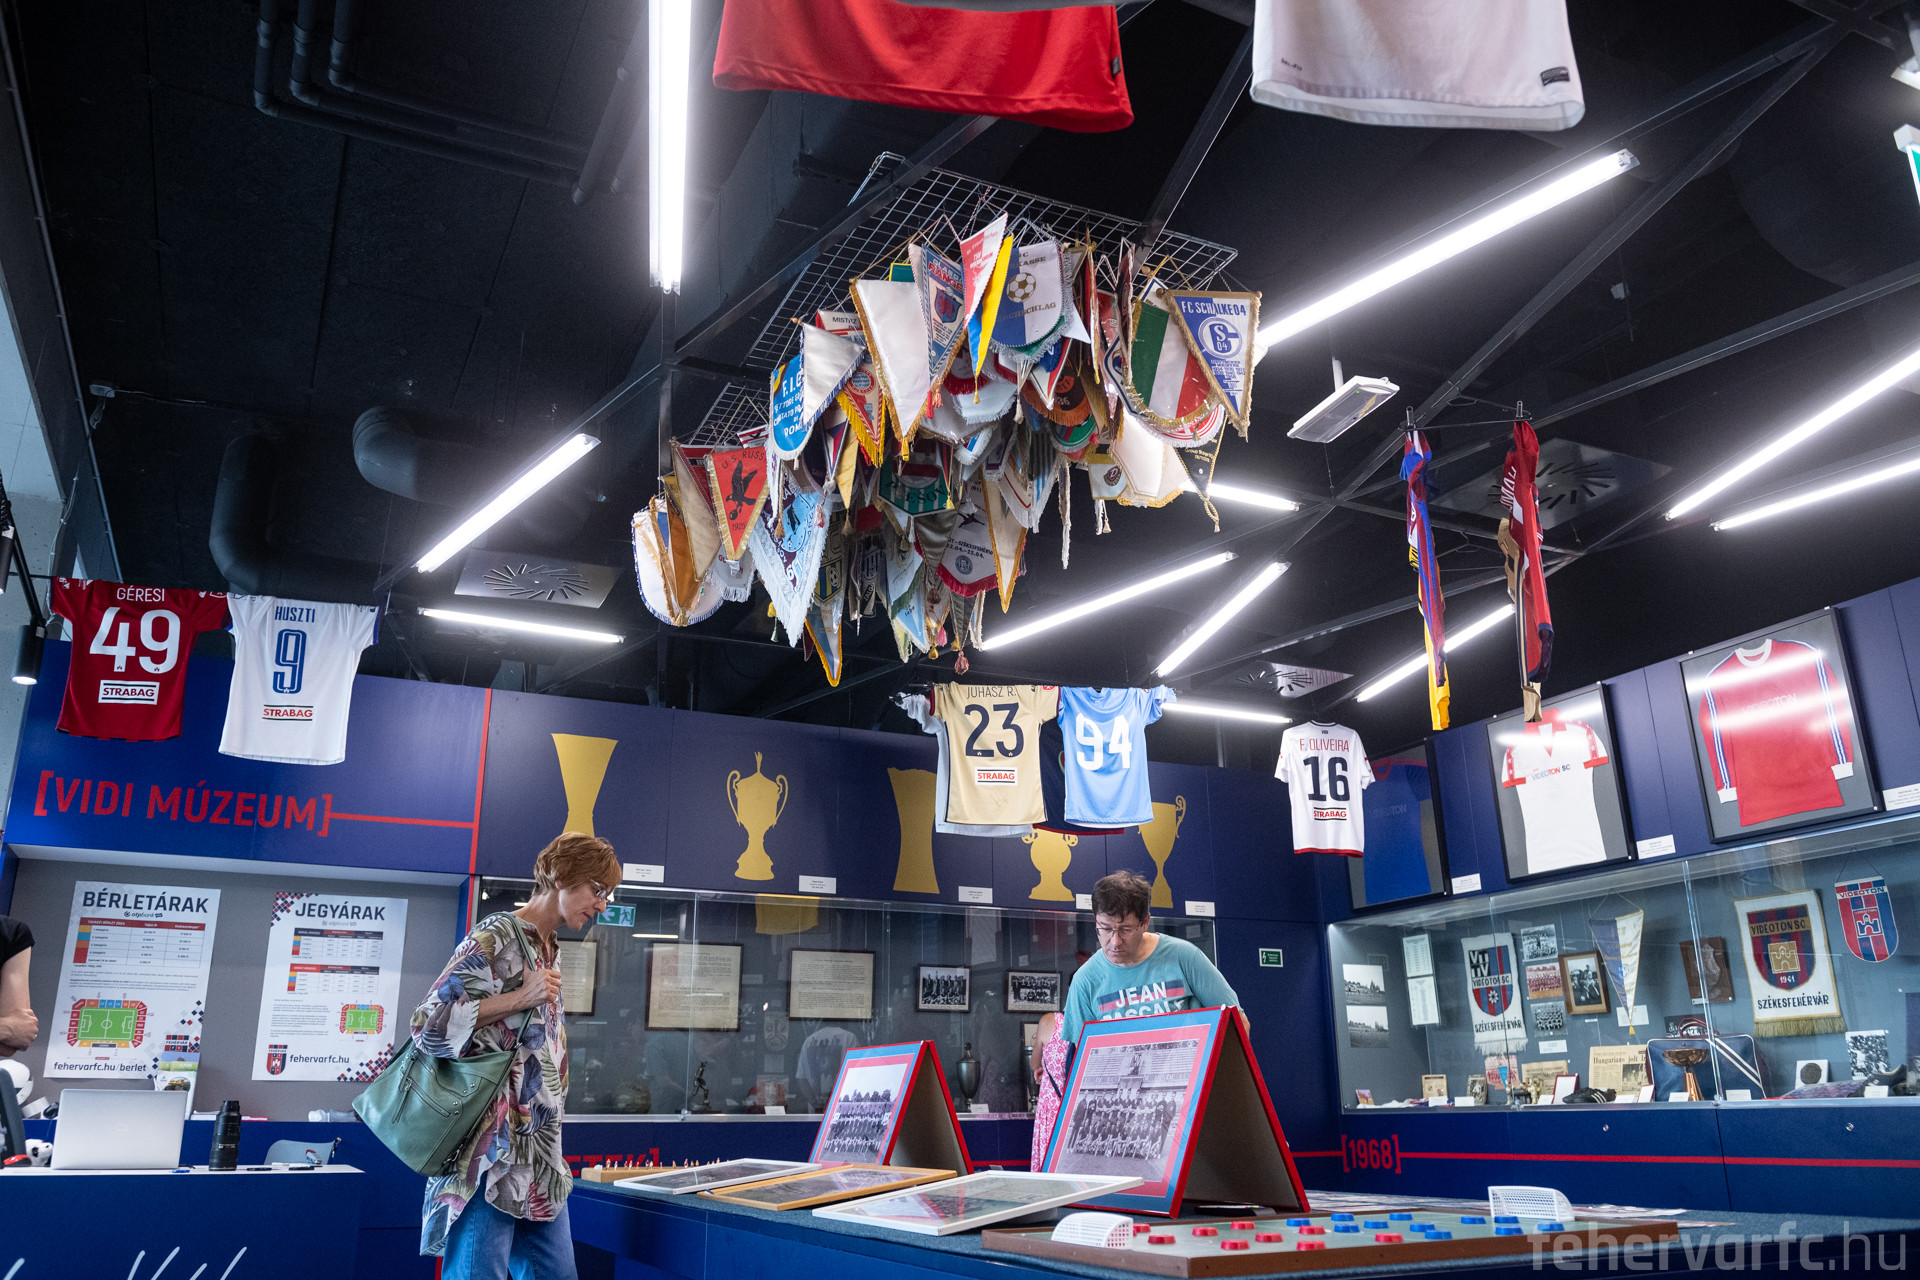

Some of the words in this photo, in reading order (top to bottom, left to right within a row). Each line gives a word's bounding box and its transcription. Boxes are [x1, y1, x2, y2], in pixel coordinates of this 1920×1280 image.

[1181, 301, 1194, 314] FC
[1195, 302, 1234, 316] SCHALKE
[1234, 304, 1247, 317] 04
[722, 462, 729, 470] U
[731, 455, 737, 463] S
[731, 521, 746, 531] 1925
[116, 583, 166, 603] GÉRESI
[274, 605, 316, 624] HUSZTI
[89, 606, 182, 674] 49
[272, 628, 308, 695] 9
[102, 684, 155, 699] STRABAG
[262, 706, 314, 720] STRABAG
[964, 702, 1025, 758] 23
[1075, 712, 1132, 771] 94
[1299, 738, 1307, 751] F.
[1309, 738, 1350, 753] OLIVEIRA
[977, 771, 1016, 781] STRABAG
[1561, 763, 1571, 772] SC
[1303, 756, 1351, 802] 16
[34, 769, 133, 817] [VIDI
[146, 779, 334, 838] MÚZEUM]
[1313, 809, 1347, 819] STRABAG
[1839, 886, 1885, 898] VIDEOTON
[82, 888, 210, 914] BÉRLETÁRAK
[295, 901, 386, 921] JEGYÁRAK
[1750, 922, 1793, 935] VIDEOTON
[1115, 981, 1168, 1009] JEAN
[1757, 991, 1830, 1010] SZÉKESFEHÉRVÁR
[289, 1054, 350, 1064] fehervarfc.hu
[1593, 1056, 1626, 1064] Hungarians
[1627, 1055, 1638, 1064] jolt
[1341, 1134, 1402, 1174] [1968]
